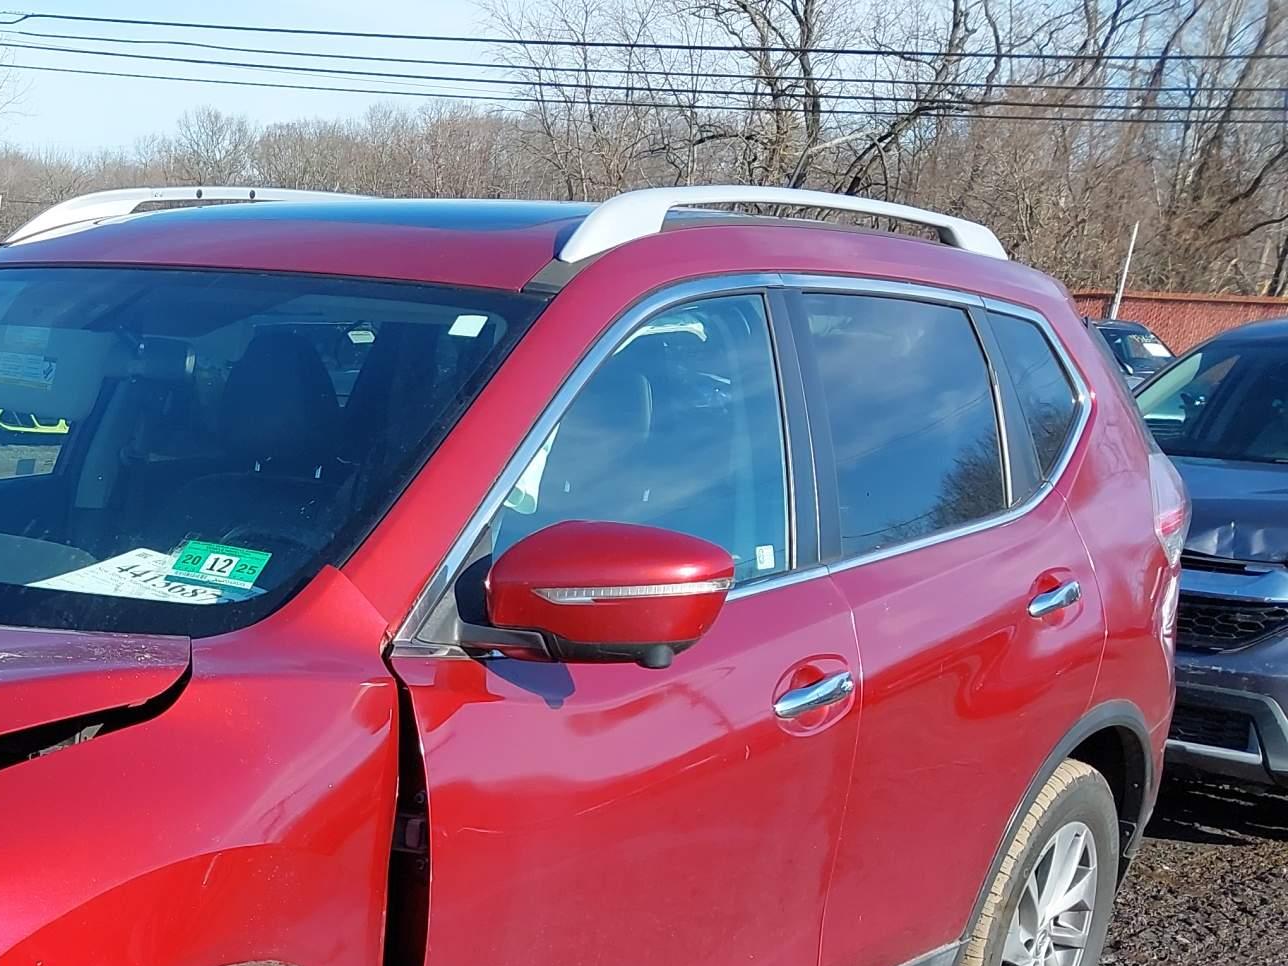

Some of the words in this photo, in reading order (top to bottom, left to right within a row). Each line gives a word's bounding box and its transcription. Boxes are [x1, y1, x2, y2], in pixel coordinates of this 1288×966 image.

[182, 553, 202, 566] 20
[206, 556, 234, 574] 12
[236, 563, 259, 575] 25
